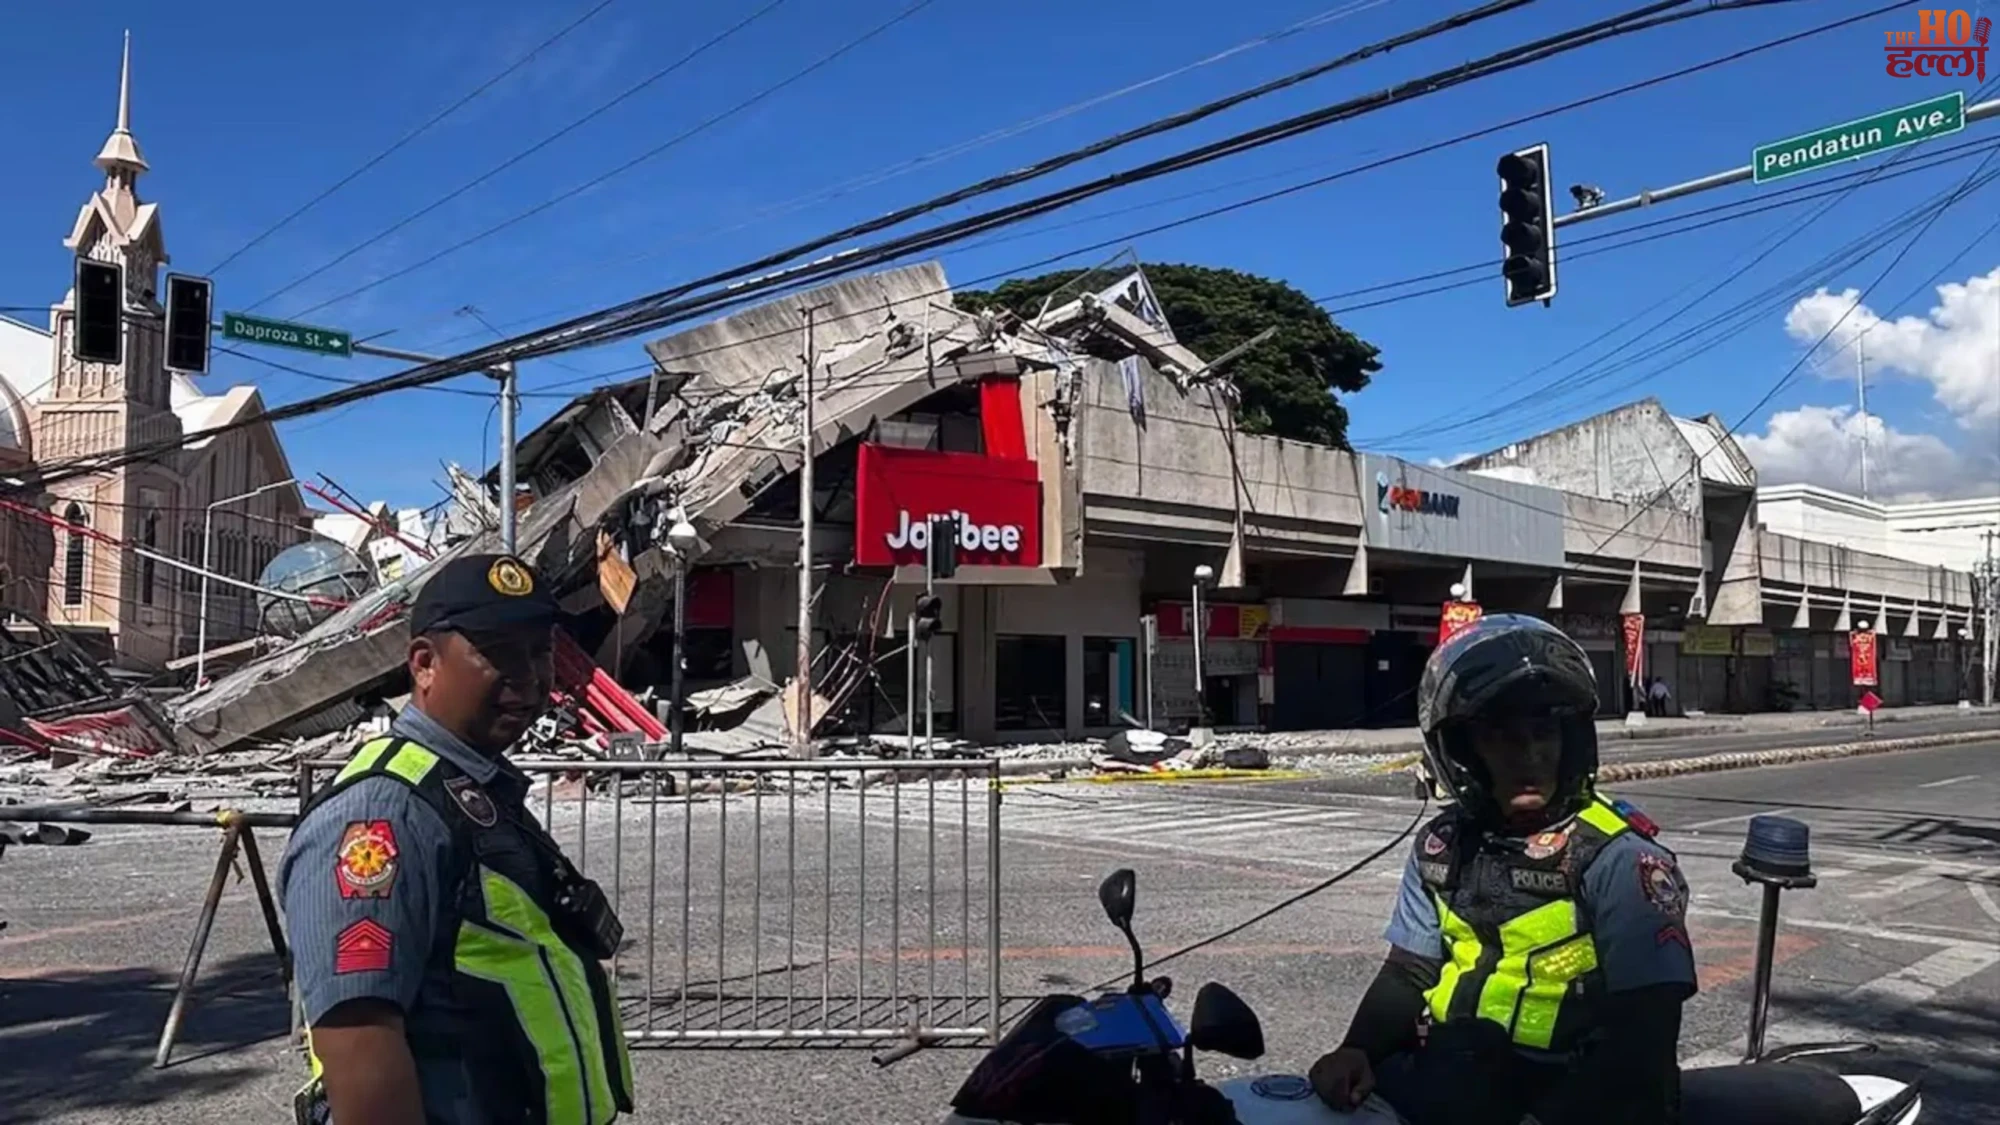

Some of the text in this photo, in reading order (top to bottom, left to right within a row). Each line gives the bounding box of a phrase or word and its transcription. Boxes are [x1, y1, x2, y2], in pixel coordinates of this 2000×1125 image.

[1763, 110, 1953, 172] Pendatun Ave.
[234, 321, 324, 347] Daproza St.
[886, 509, 1021, 551] Joibee
[1512, 868, 1564, 891] POLICE
